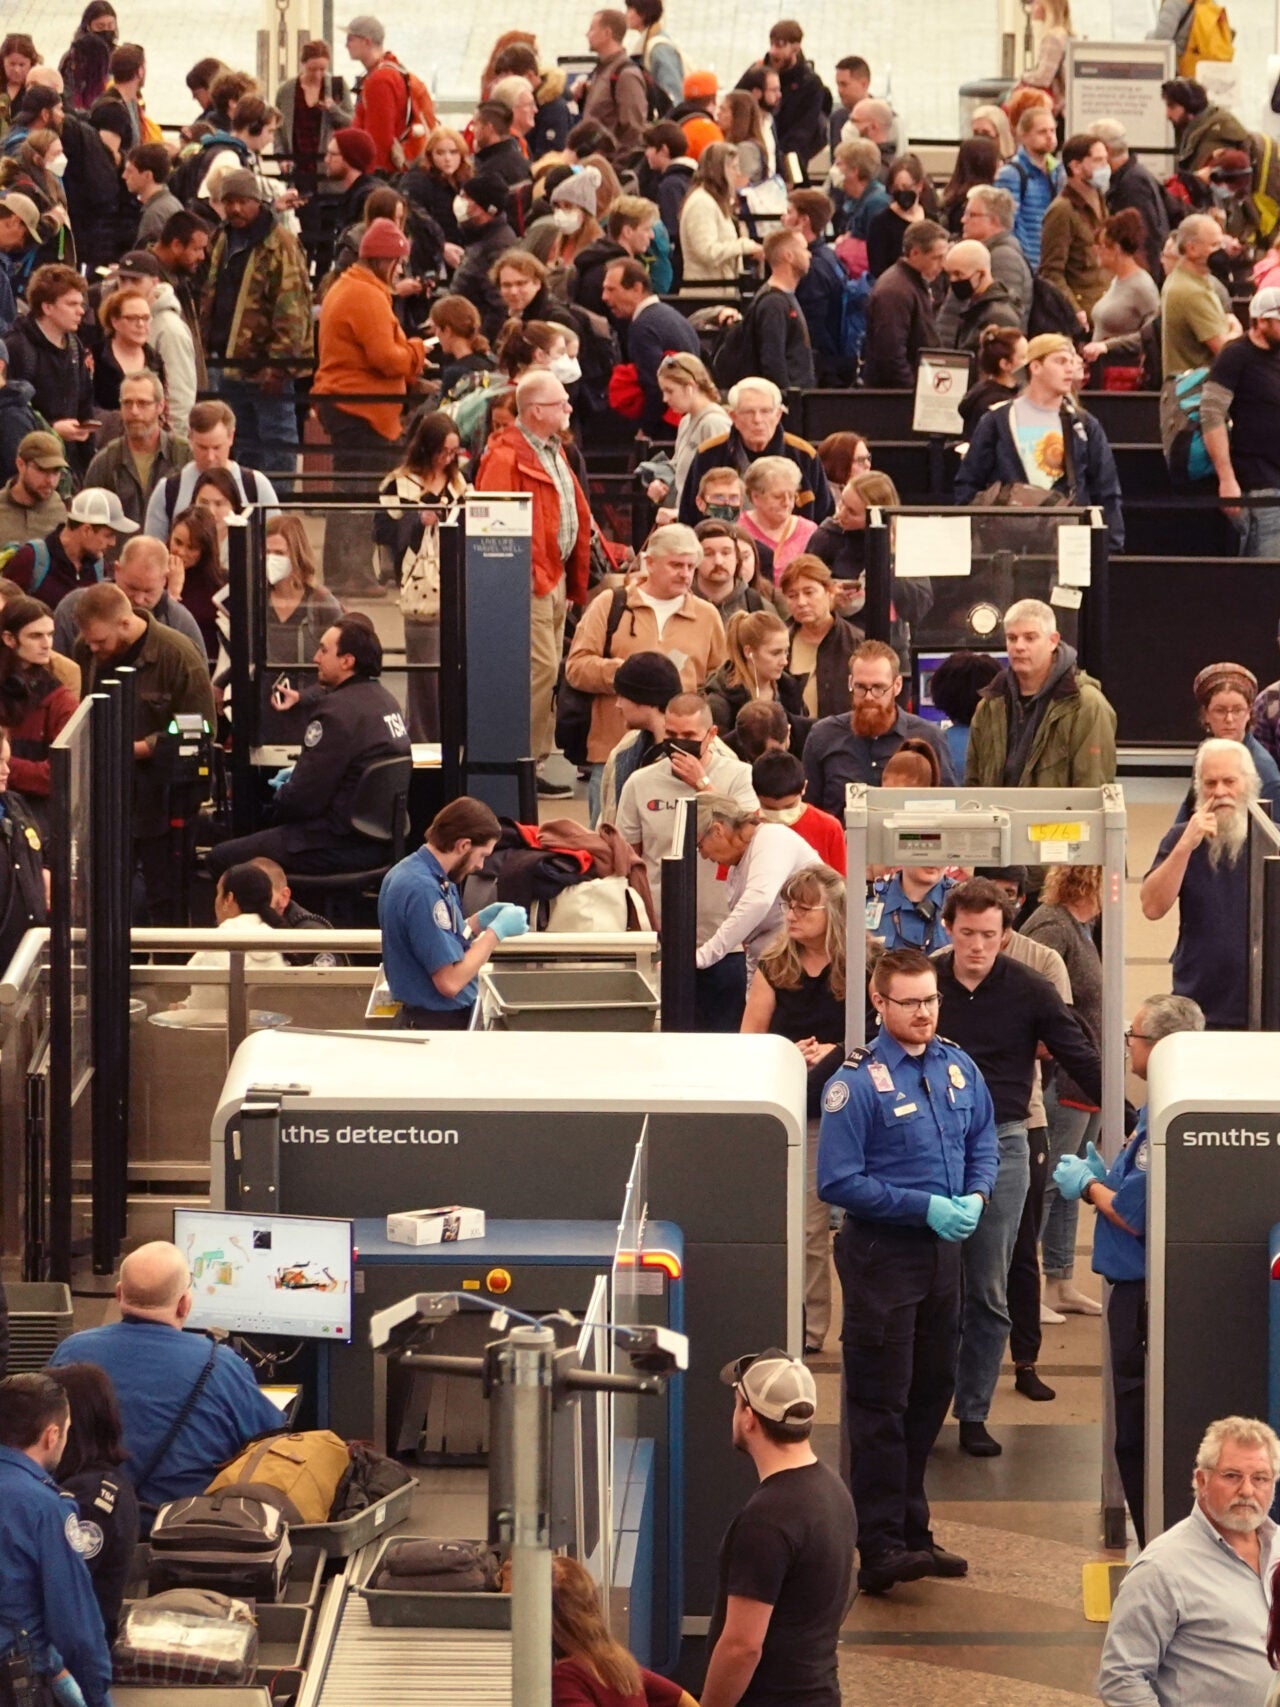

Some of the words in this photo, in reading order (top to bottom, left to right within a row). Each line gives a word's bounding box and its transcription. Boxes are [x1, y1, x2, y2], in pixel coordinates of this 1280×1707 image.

[336, 1126, 459, 1144] detection
[1183, 1128, 1270, 1146] smiths
[101, 1488, 115, 1503] TSA
